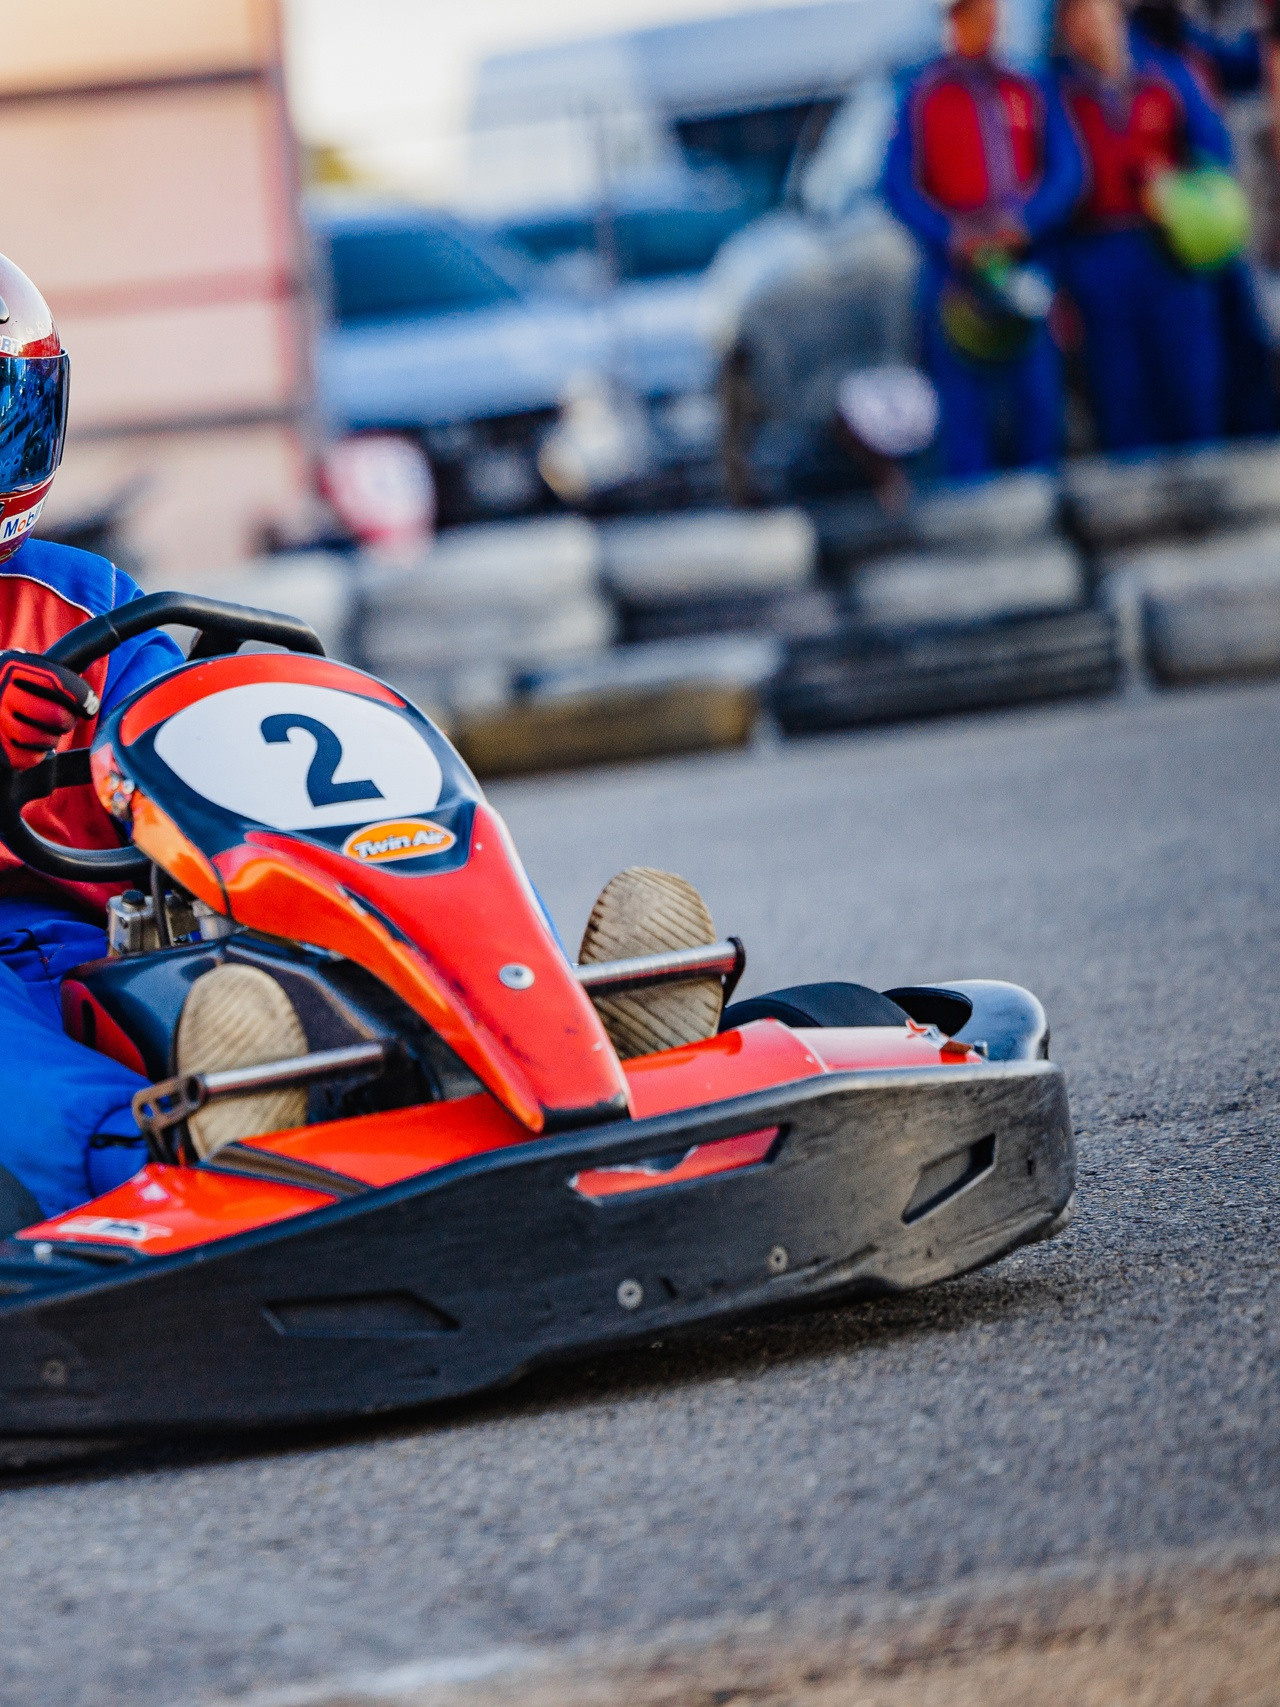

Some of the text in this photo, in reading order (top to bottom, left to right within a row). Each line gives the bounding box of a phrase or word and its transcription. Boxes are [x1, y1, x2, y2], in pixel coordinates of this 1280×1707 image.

[260, 713, 386, 808] 2
[353, 830, 446, 858] Twin Air
